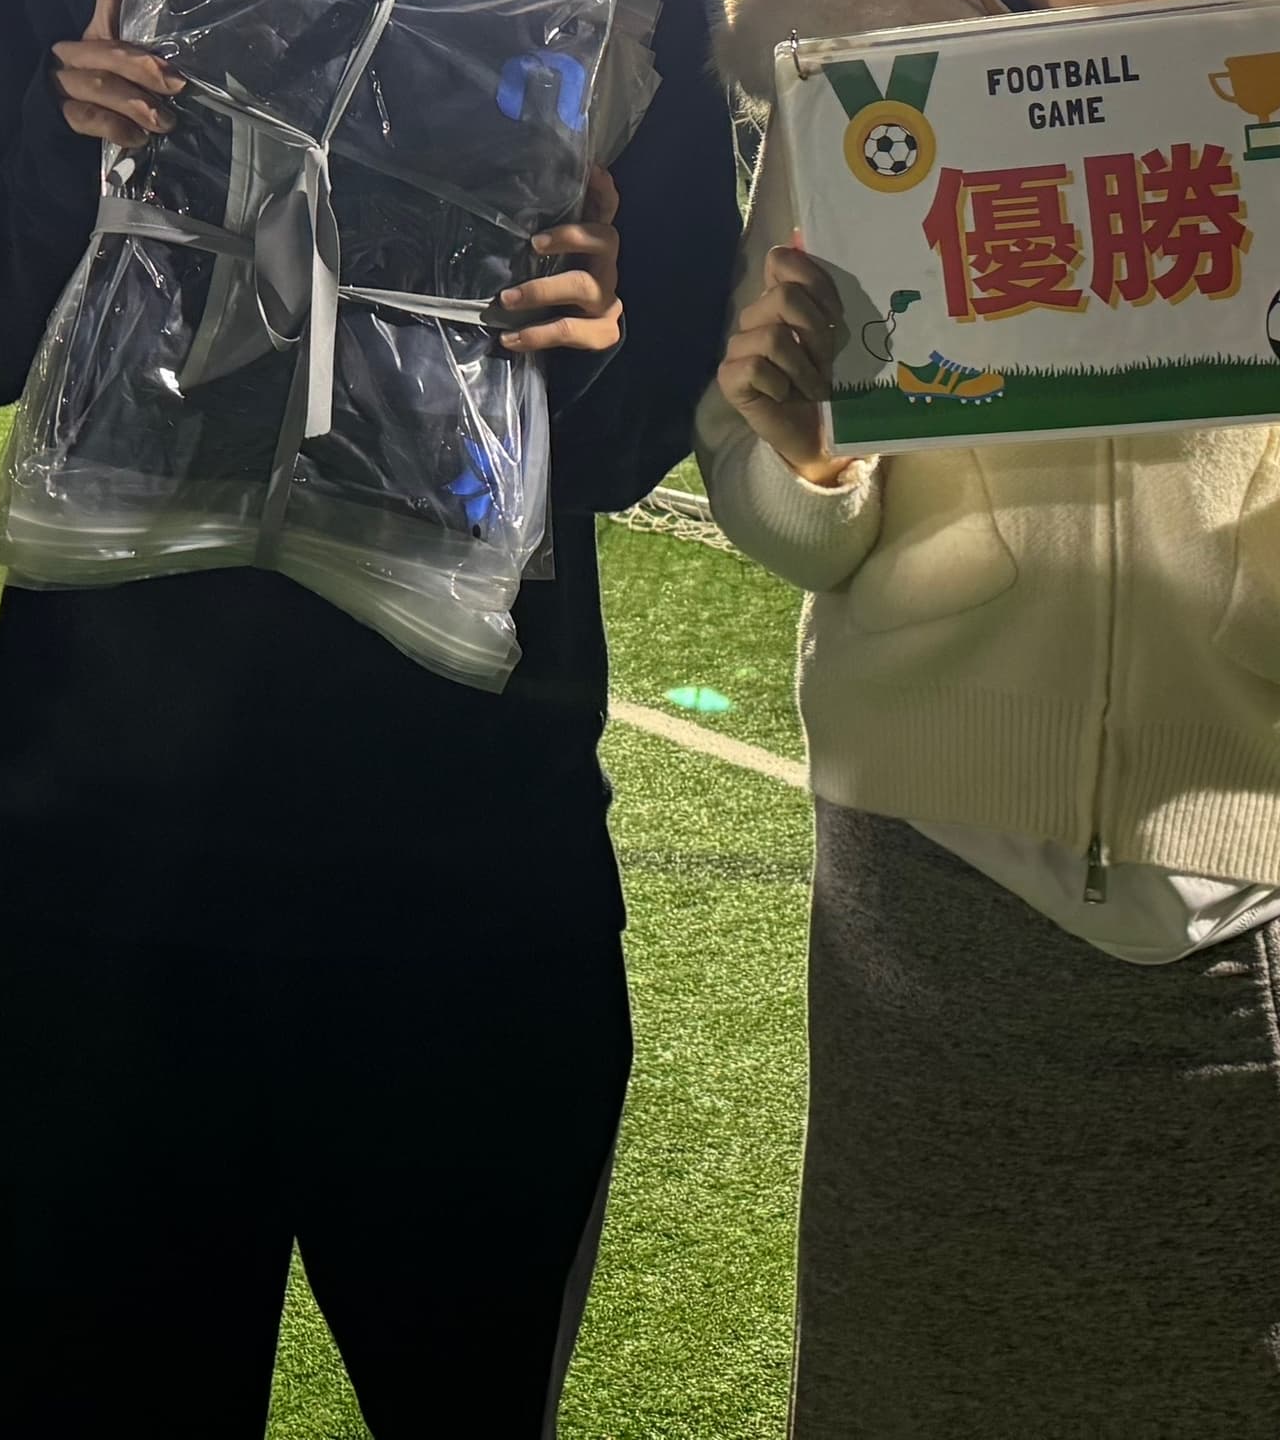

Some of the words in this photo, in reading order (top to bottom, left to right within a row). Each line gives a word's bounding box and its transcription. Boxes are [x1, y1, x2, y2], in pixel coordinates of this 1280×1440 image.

[986, 54, 1140, 96] FOOTBALL
[1028, 96, 1106, 130] GAME
[923, 142, 1251, 323] 優勝
